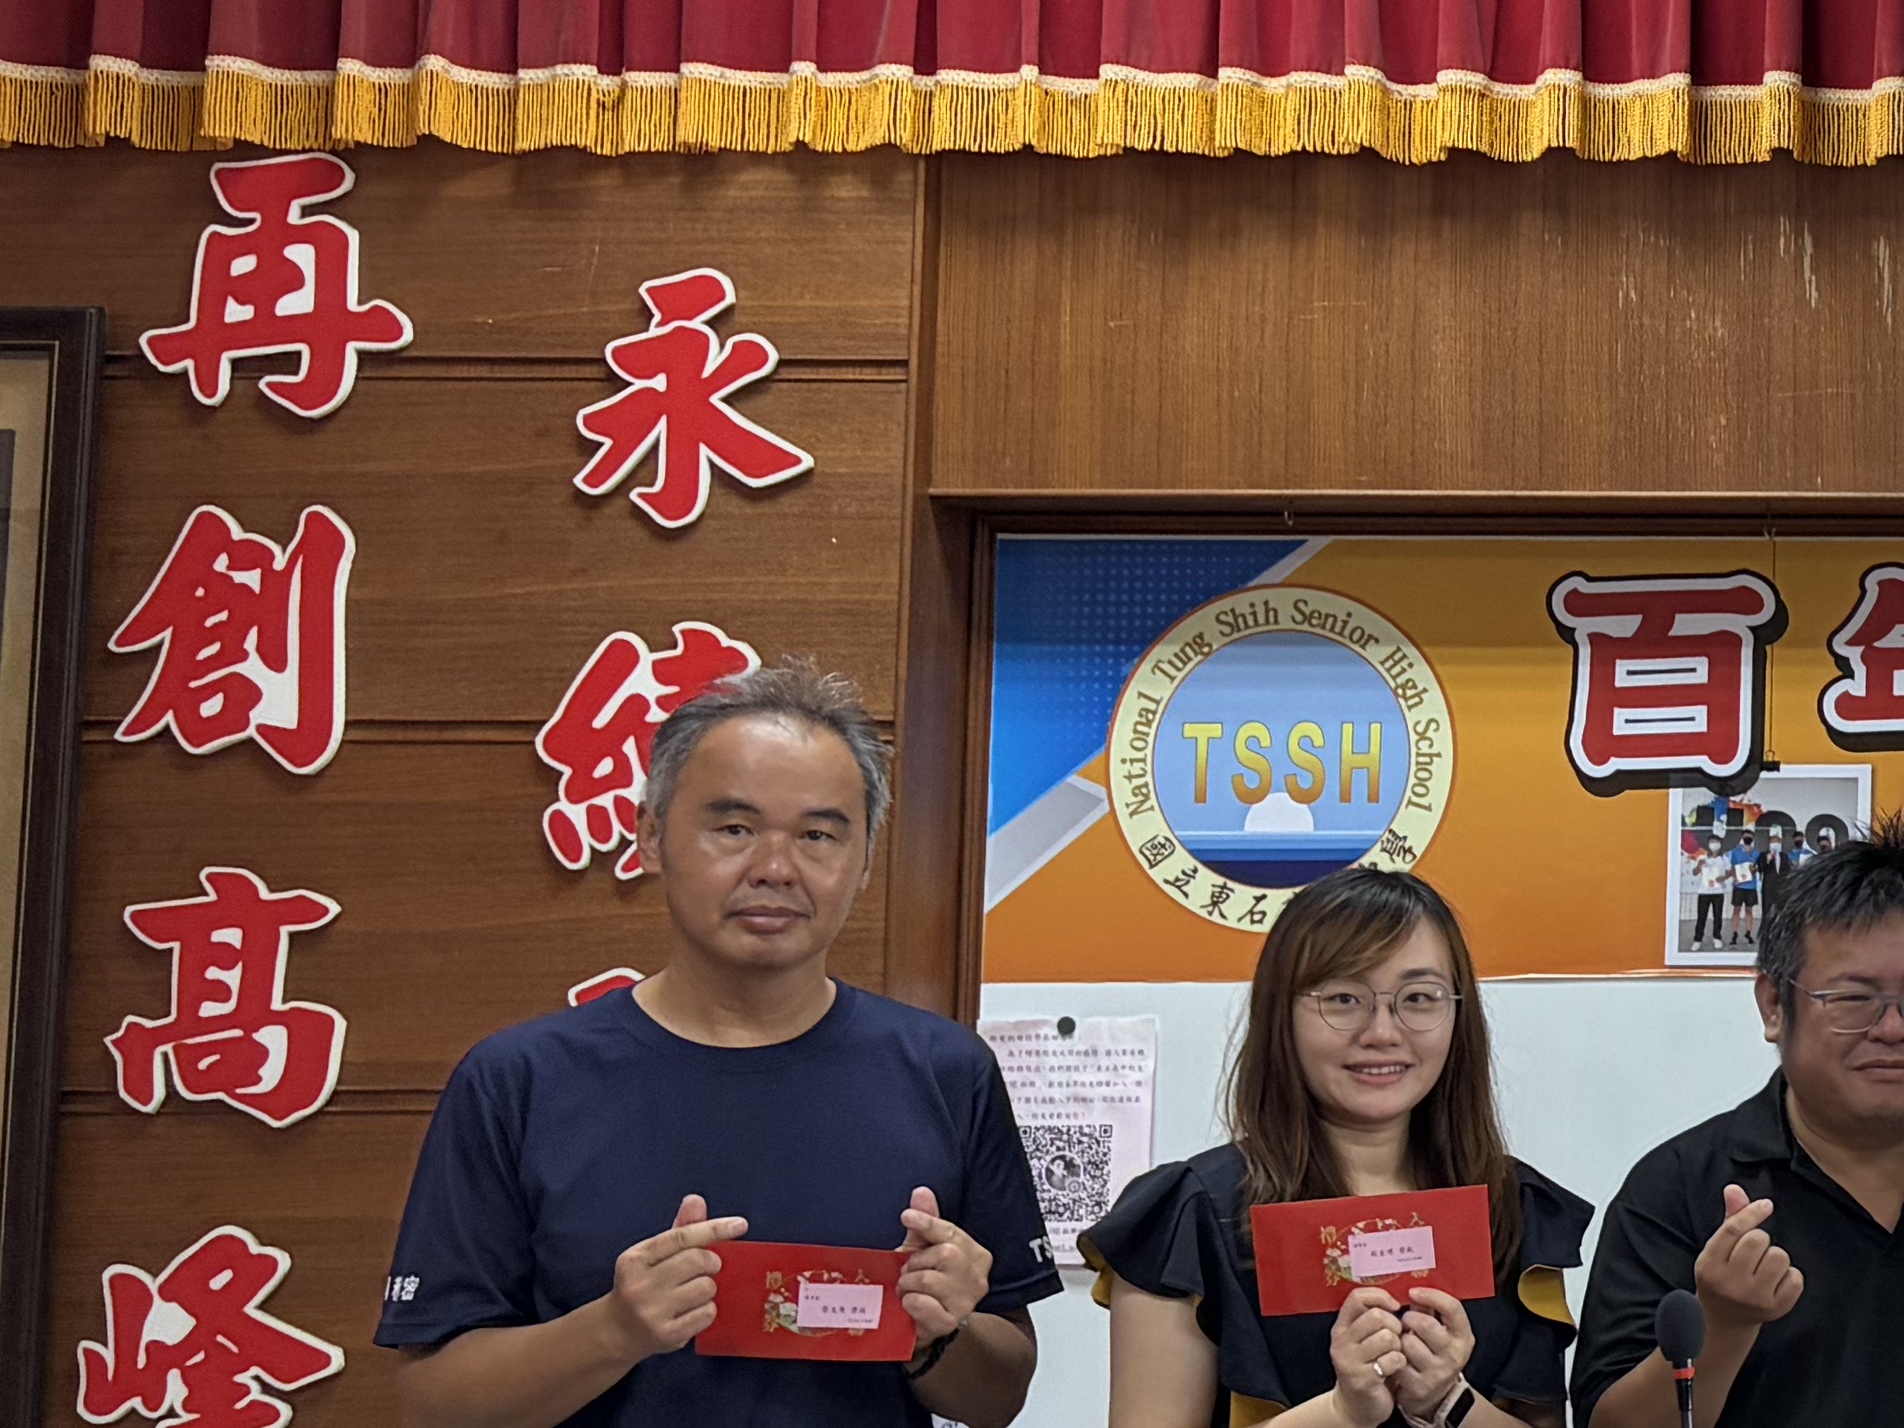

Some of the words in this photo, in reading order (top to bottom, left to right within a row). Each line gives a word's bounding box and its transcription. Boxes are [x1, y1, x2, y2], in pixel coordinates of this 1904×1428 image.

[1215, 599, 1280, 638] Shih
[1290, 598, 1381, 652] Senior
[1151, 631, 1214, 686] Tung
[1379, 645, 1430, 713] High
[1120, 690, 1165, 820] National
[1182, 721, 1383, 805] TSSH
[1404, 716, 1442, 814] School
